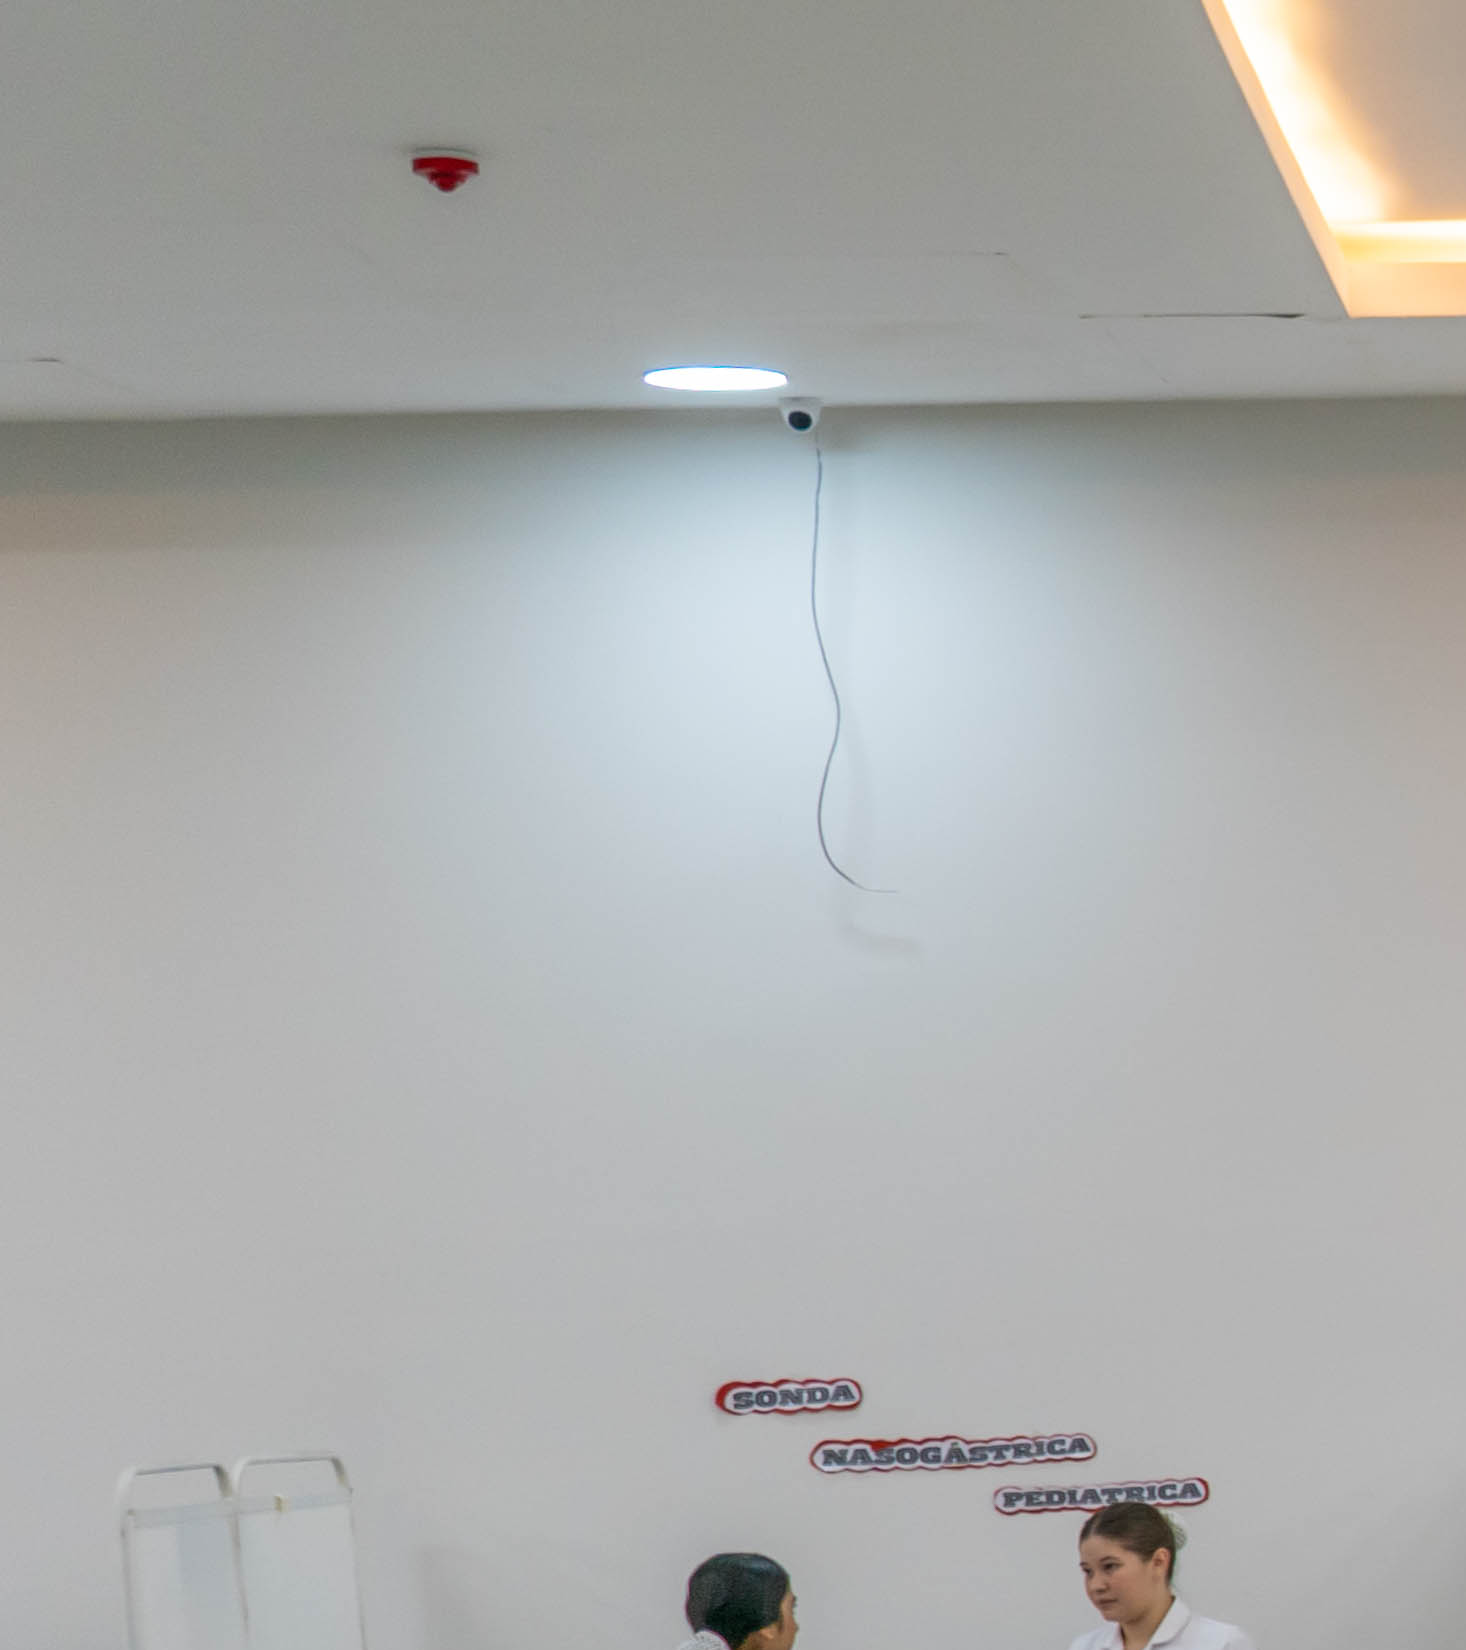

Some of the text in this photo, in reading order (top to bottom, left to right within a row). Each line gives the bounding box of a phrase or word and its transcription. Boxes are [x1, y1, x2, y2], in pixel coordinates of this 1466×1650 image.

[733, 1384, 855, 1410] SONDA
[821, 1437, 1091, 1467] NASOGÁSTRICA
[1002, 1482, 1202, 1508] PEDIATRICA
